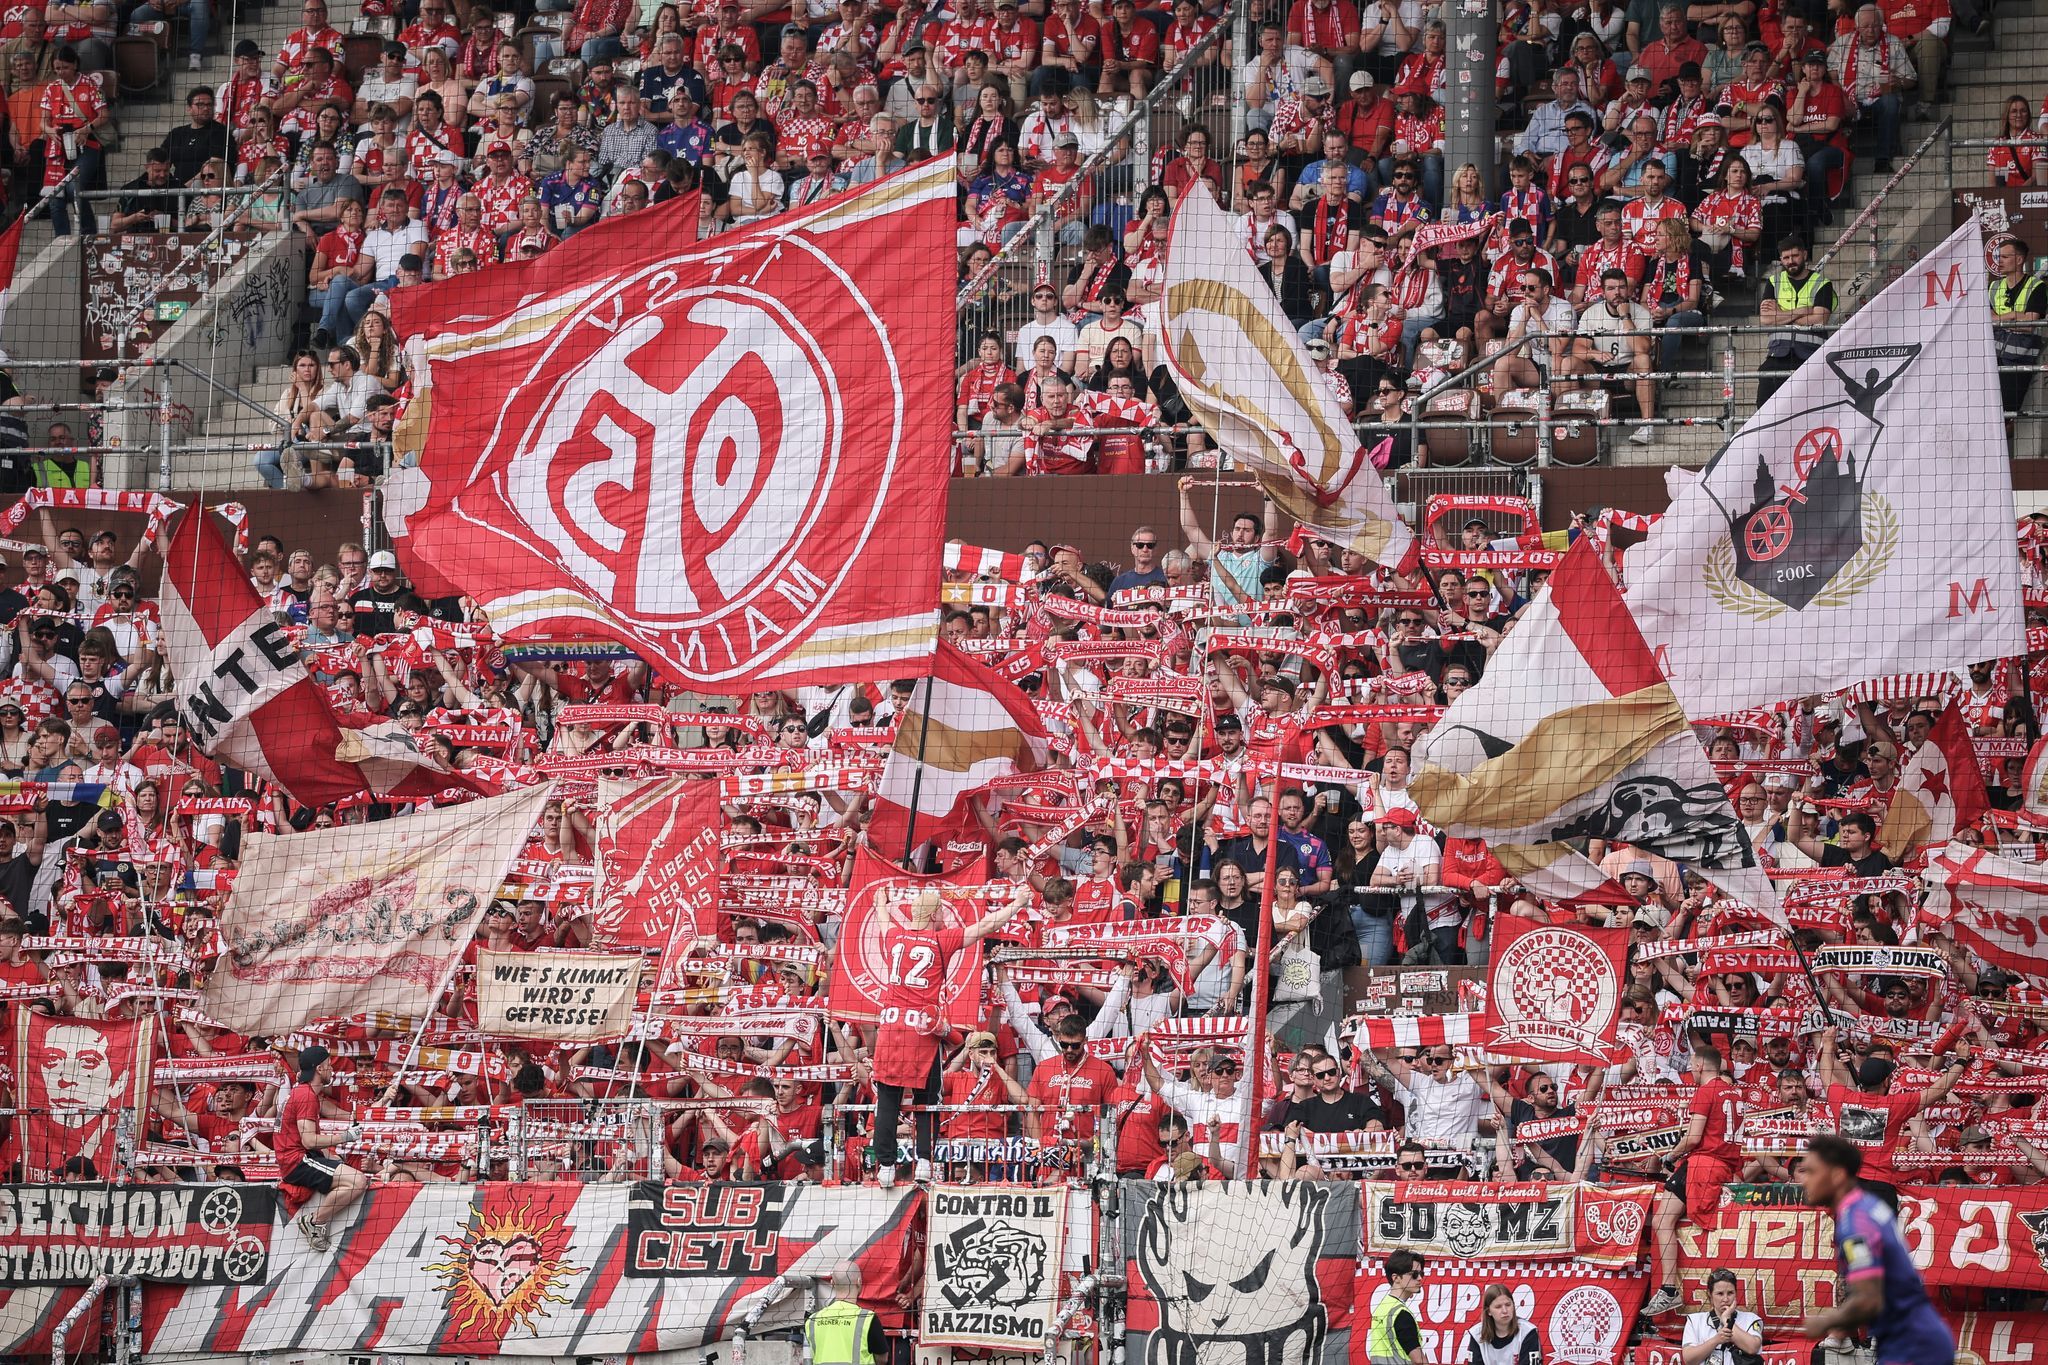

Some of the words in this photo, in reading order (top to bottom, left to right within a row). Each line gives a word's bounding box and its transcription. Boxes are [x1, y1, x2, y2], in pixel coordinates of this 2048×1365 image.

[1453, 495, 1489, 506] MEIN
[1420, 552, 1453, 565] FSV
[1459, 552, 1524, 565] MAINZ
[1529, 551, 1555, 565] 05
[527, 644, 560, 657] FSV
[563, 643, 621, 656] MAINZ
[1227, 637, 1259, 650] FSV
[1262, 639, 1315, 658] MAINZ
[328, 658, 359, 671] FSV
[672, 714, 695, 723] FSV
[699, 714, 744, 725] MAINZ
[1356, 706, 1428, 721] MAINZ
[853, 727, 889, 736] MEIN
[659, 750, 689, 760] FSV
[693, 749, 748, 761] MAINZ
[752, 750, 775, 760] 05
[1289, 767, 1311, 776] FSV
[1314, 768, 1351, 779] MAINZ
[648, 889, 681, 915] PER
[685, 857, 716, 888] GLI
[1067, 925, 1108, 940] FSV
[1111, 917, 1183, 937] MAINZ
[1186, 916, 1216, 933] 05
[1508, 933, 1555, 968] GRUPPO
[1558, 933, 1608, 977] UBRIACO
[1713, 953, 1750, 968] FSV
[890, 942, 935, 988] 12
[1284, 958, 1311, 973] HARTE
[559, 967, 629, 986] KIMMT,
[1281, 976, 1312, 990] SCHORLE
[738, 994, 778, 1009] FSV
[506, 1008, 608, 1026] GEFRESSE!
[1691, 1016, 1731, 1029] PAUL
[1517, 1024, 1585, 1043] RHEINGAU
[1087, 1037, 1128, 1053] FSV
[688, 1055, 751, 1075] NULL
[1612, 1087, 1669, 1101] GRUPPO
[1522, 1117, 1580, 1138] GRUPPO
[1345, 1132, 1396, 1154] VITA
[29, 1167, 54, 1182] TAKE
[1405, 1182, 1451, 1198] friends
[1454, 1183, 1477, 1197] will
[1480, 1183, 1496, 1197] be
[1497, 1184, 1542, 1200] friends
[0, 1188, 195, 1239] SEKTION
[660, 1186, 766, 1228] SUB
[934, 1193, 1029, 1218] CONTRO
[1035, 1194, 1056, 1218] IL
[1495, 1196, 1564, 1244] MZ
[635, 1229, 777, 1272] CIETY
[1558, 1290, 1585, 1316] GRUPPO
[1587, 1290, 1615, 1314] UBRIACO
[928, 1312, 1045, 1339] RAZZISMO
[1563, 1347, 1604, 1358] RHEINGAU
